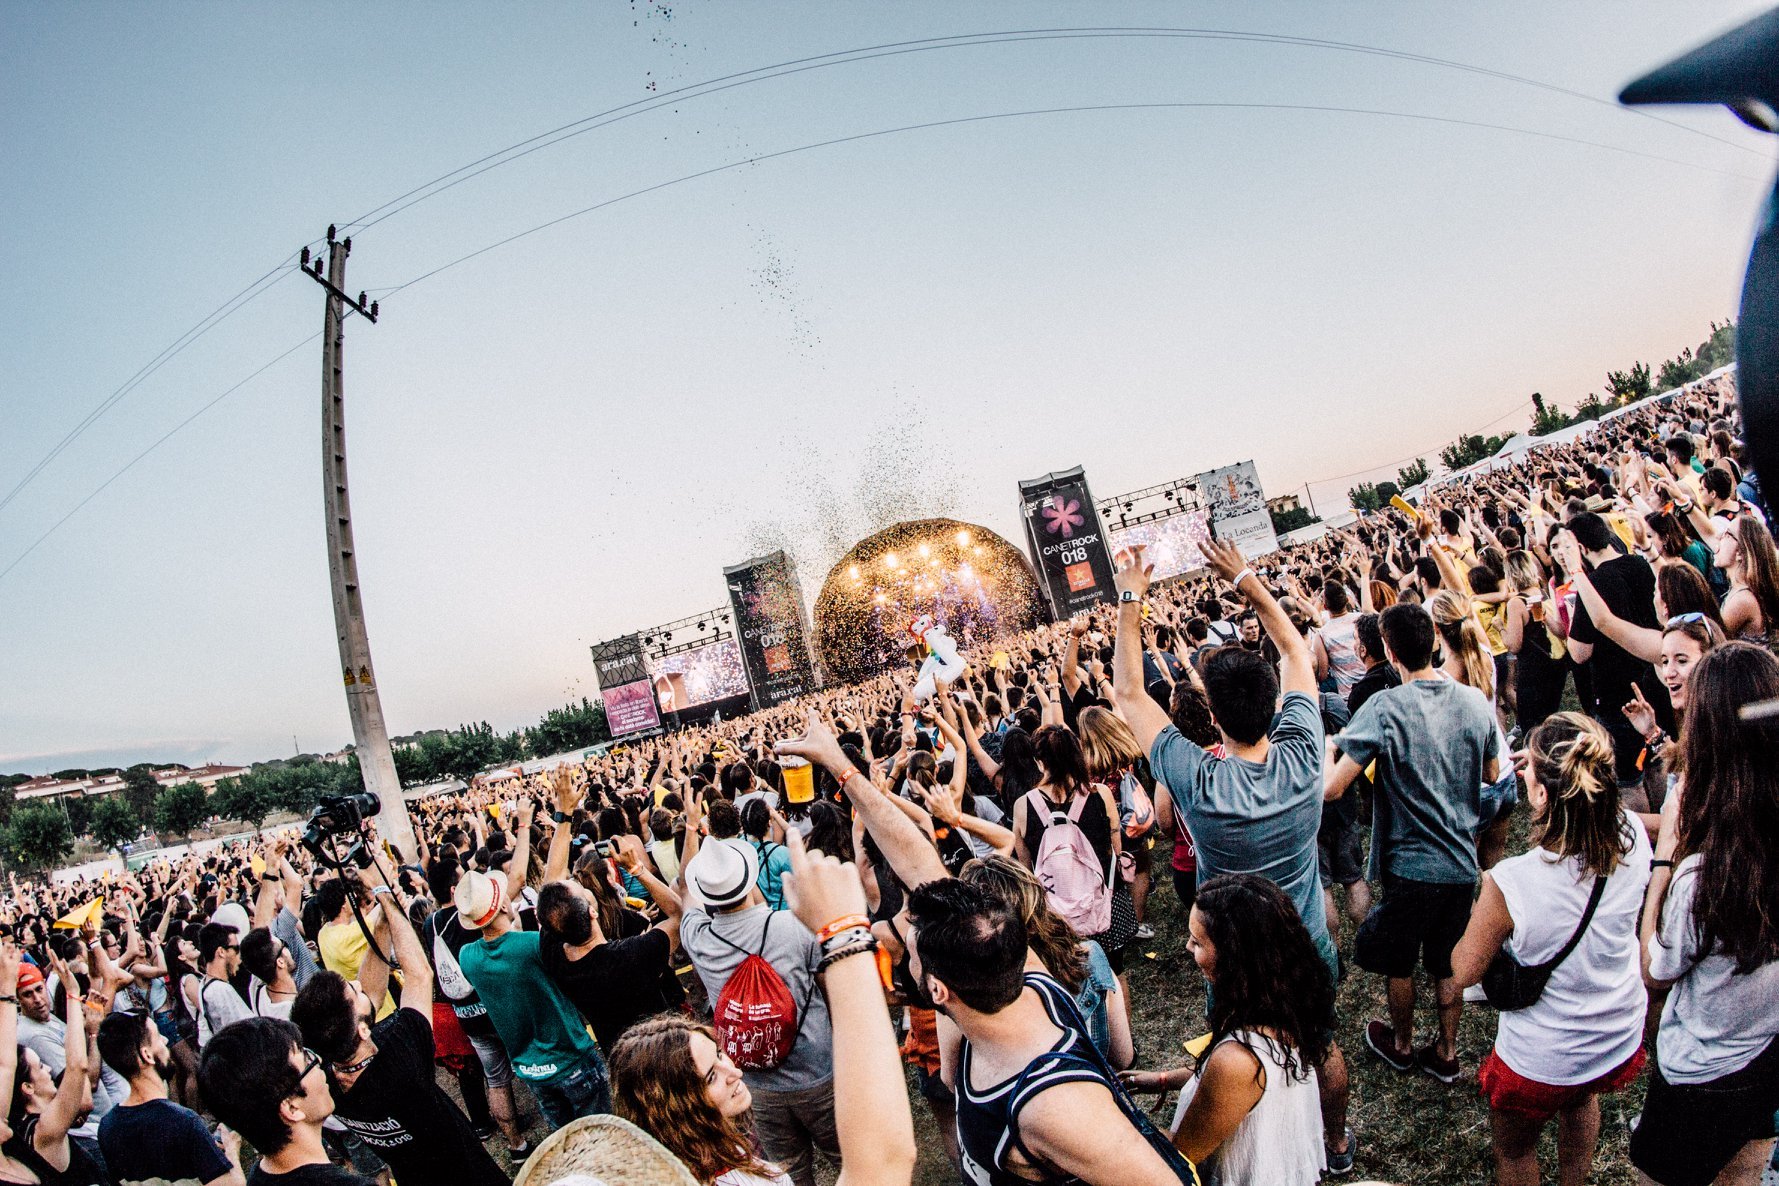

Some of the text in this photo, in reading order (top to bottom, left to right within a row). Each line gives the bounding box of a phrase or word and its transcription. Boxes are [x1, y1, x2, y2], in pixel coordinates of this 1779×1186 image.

[1234, 521, 1268, 537] Locanda
[1043, 533, 1099, 555] CANETROCK
[1061, 547, 1088, 565] 018
[601, 654, 637, 672] ara.cat
